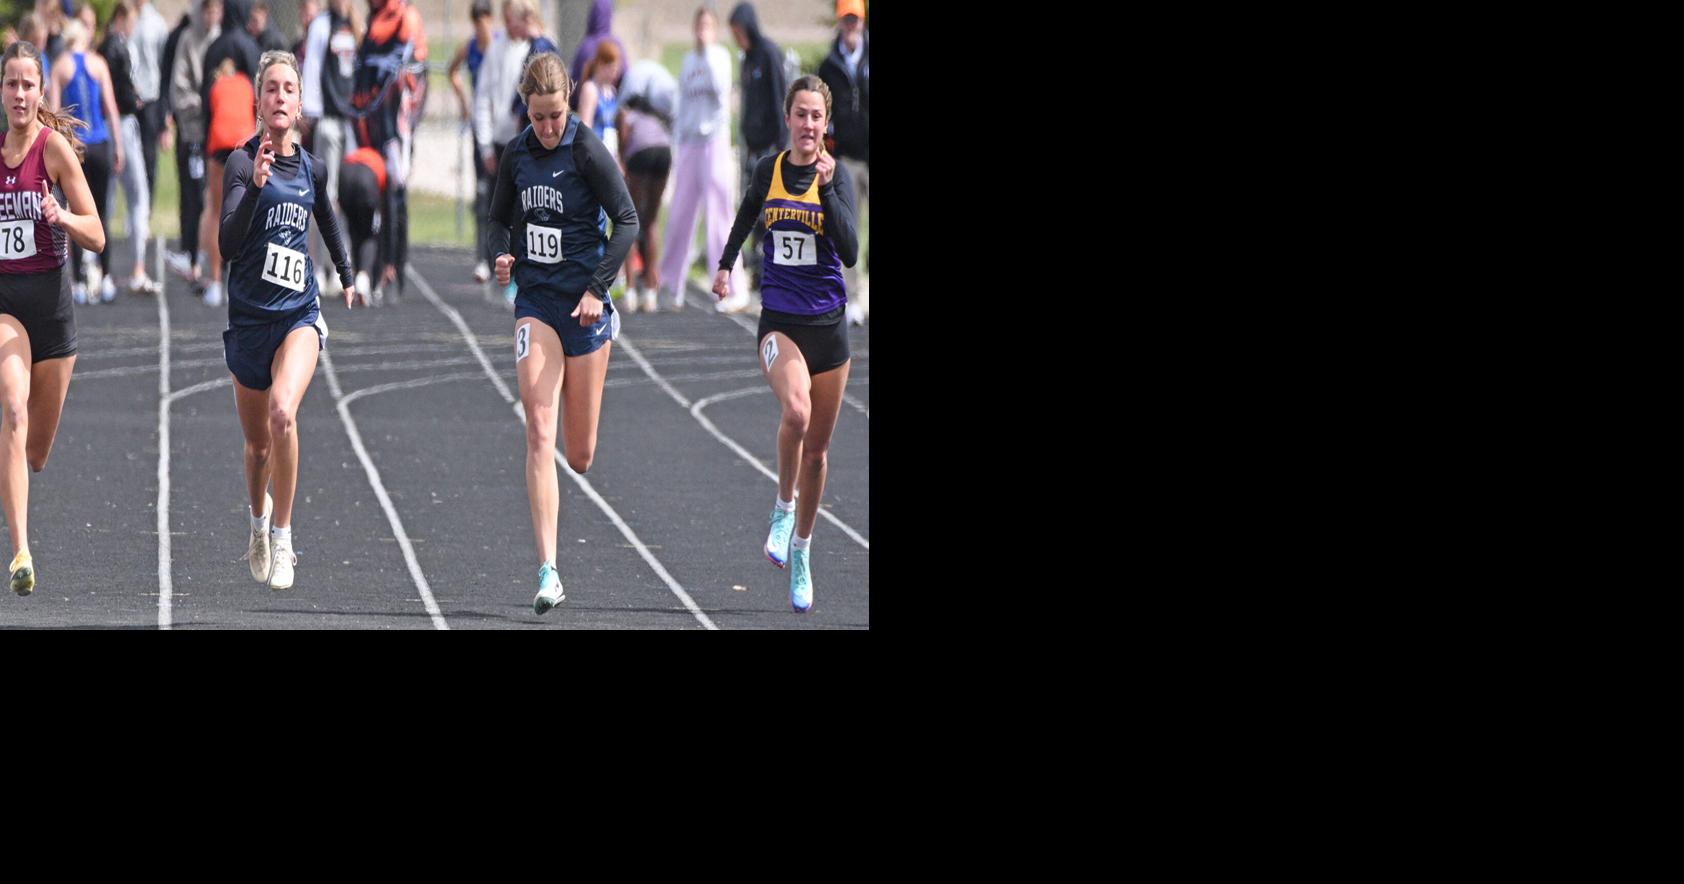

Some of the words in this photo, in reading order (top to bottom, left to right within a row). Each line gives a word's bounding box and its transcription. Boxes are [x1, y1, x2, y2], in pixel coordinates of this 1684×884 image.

[521, 185, 563, 214] RAIDERS
[265, 202, 308, 232] RAIDERS
[764, 207, 825, 237] CENTERVILLE
[1, 226, 26, 254] 78
[529, 231, 559, 258] 119
[782, 236, 806, 260] 57
[266, 252, 303, 285] 116
[517, 327, 526, 358] 3
[764, 340, 776, 368] 2
